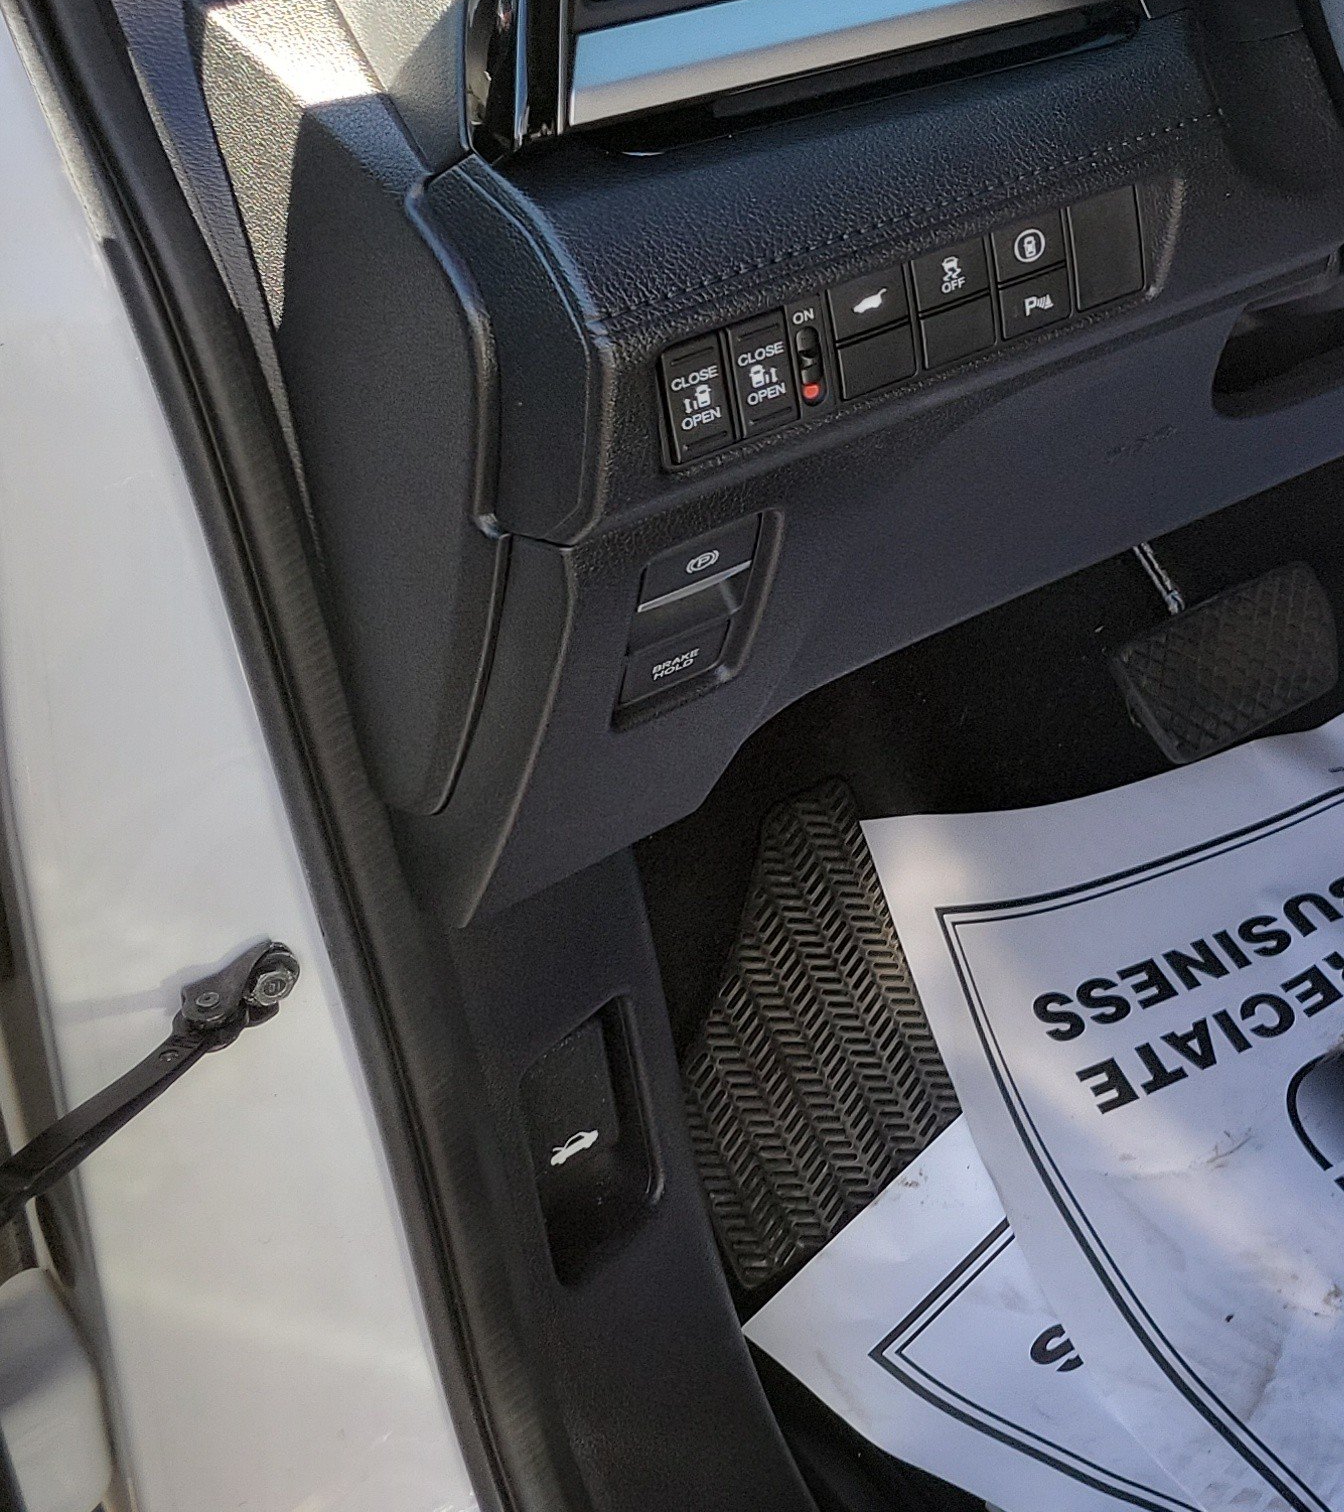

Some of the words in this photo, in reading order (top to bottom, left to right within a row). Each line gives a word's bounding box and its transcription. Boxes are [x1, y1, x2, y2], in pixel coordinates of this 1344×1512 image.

[941, 276, 966, 294] OFF
[793, 308, 815, 325] ON
[737, 341, 785, 367] CLOSE
[671, 365, 719, 392] CLOSE
[747, 382, 787, 406] OPEN
[681, 406, 722, 431] OPEN
[652, 647, 700, 675] BRAKE
[653, 658, 694, 681] HOLD
